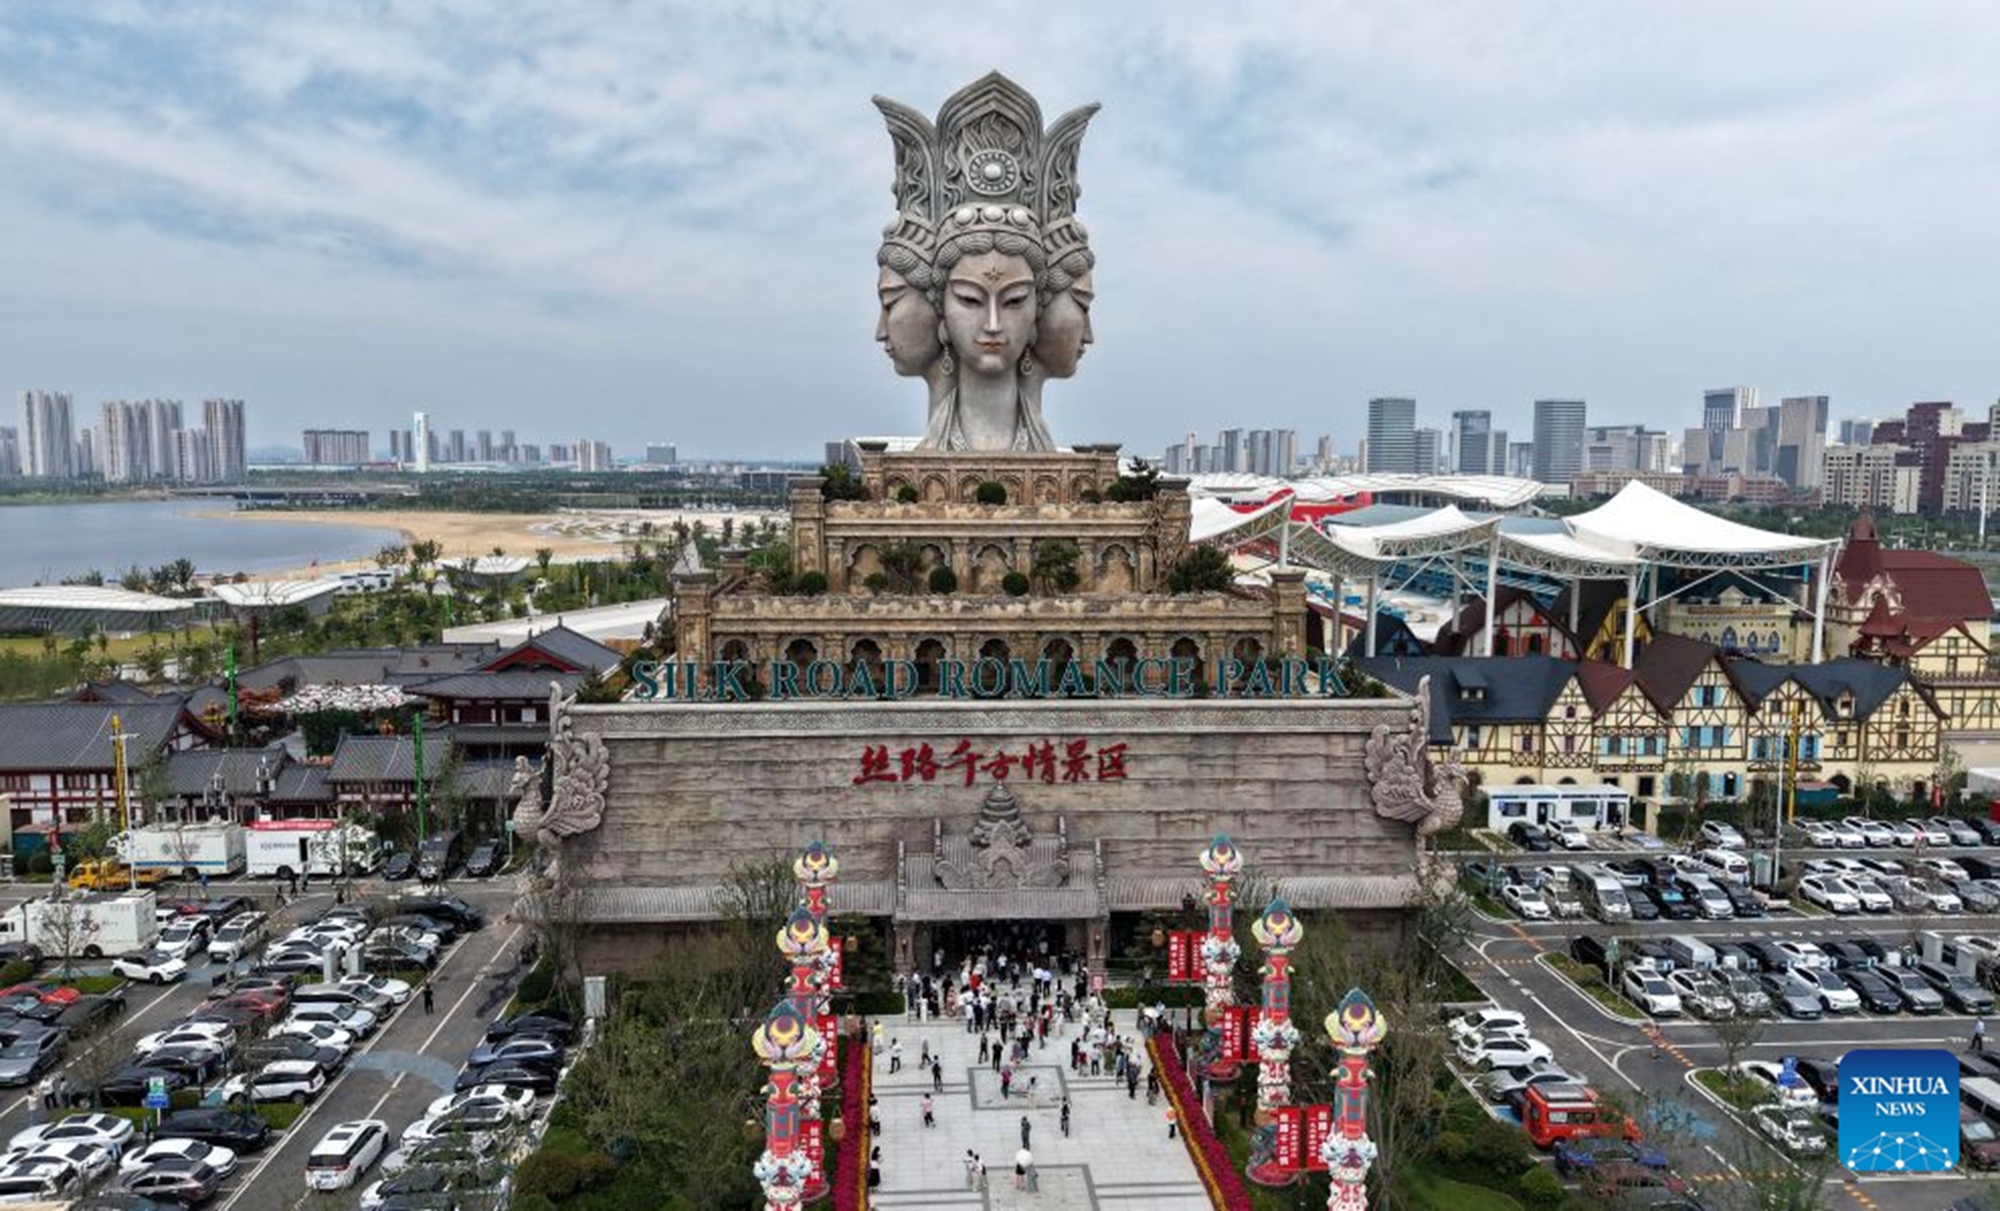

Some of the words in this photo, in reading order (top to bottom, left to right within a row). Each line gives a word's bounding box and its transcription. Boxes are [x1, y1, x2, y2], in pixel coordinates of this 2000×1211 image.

[632, 659, 750, 700] SILK
[768, 658, 919, 699] ROAD
[937, 657, 1195, 699] ROMANCE
[1215, 657, 1349, 698] PARK
[853, 739, 1128, 788] 丝路千古情景区
